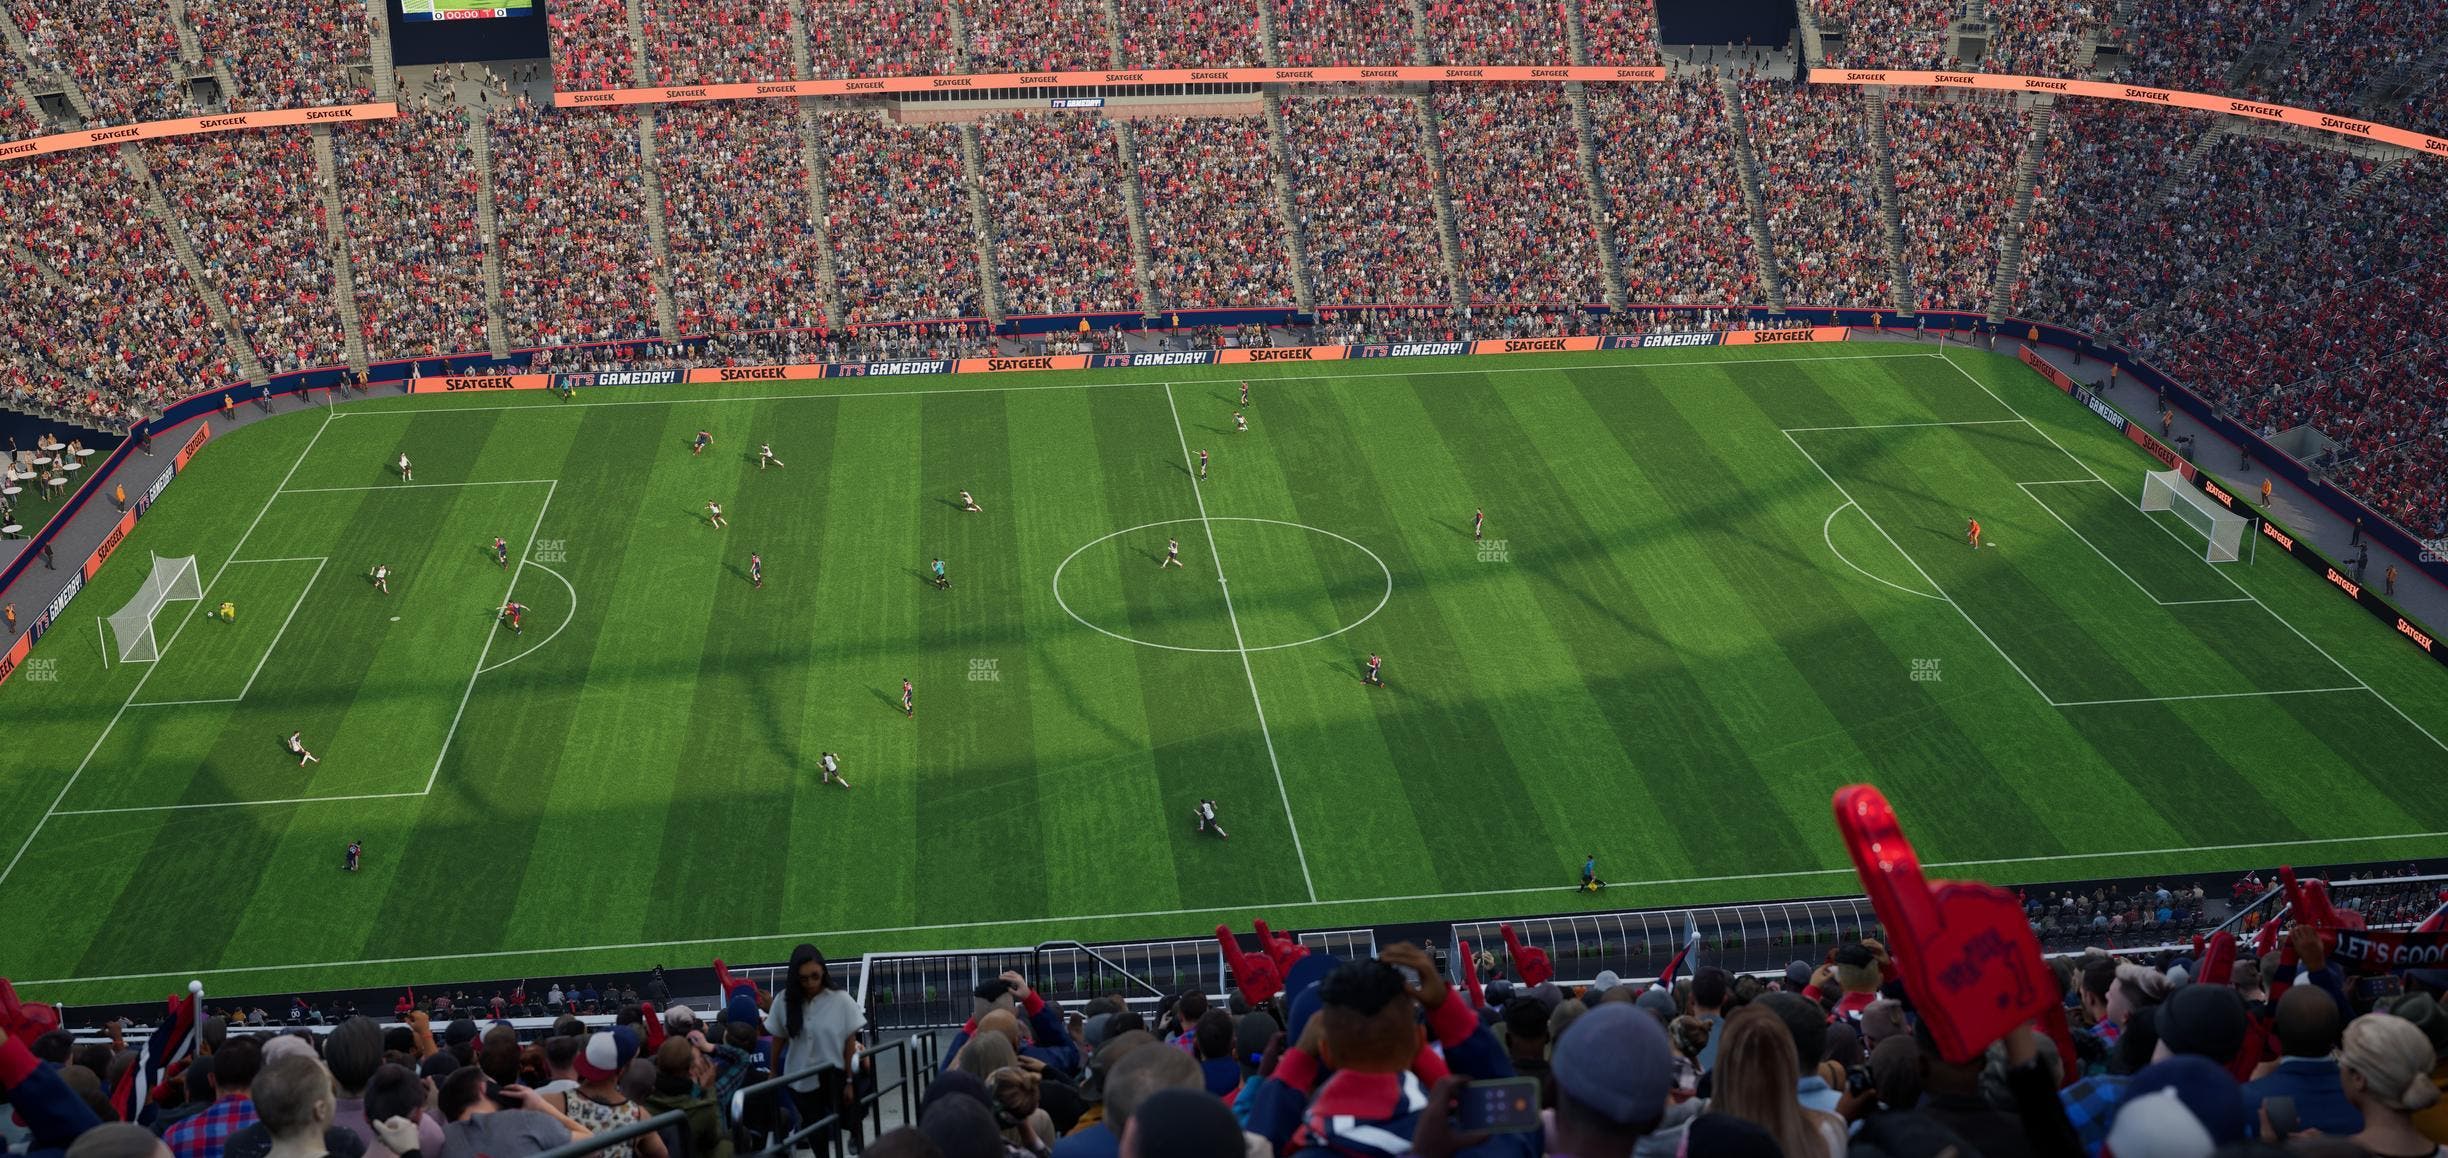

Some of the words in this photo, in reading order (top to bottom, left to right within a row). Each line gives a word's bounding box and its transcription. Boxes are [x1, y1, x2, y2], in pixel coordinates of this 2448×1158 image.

[446, 11, 479, 19] 00:00
[1020, 75, 1058, 85] SEATGEEK
[1105, 73, 1144, 82] SEATGEEK
[1191, 71, 1229, 81] SEATGEEK
[1276, 70, 1314, 80] SEATGEEK
[1360, 69, 1399, 78] SEATGEEK
[1445, 69, 1483, 78] SEATGEEK
[1531, 69, 1569, 78] SEATGEEK
[1617, 69, 1655, 78] SEATGEEK
[1847, 72, 1886, 82] SEATGEEK
[1935, 74, 1975, 85] SEATGEEK
[757, 85, 796, 95] SEATGEEK
[846, 81, 885, 91] SEATGEEK
[933, 78, 972, 88] SEATGEEK
[2025, 79, 2068, 91] SEATGEEK
[574, 93, 615, 103] SEATGEEK
[666, 89, 707, 99] SEATGEEK
[2125, 88, 2170, 102] SEATGEEK
[306, 108, 353, 120] SEATGEEK
[2230, 102, 2284, 118] SEATGEEK
[200, 115, 247, 129] SEATGEEK
[2320, 116, 2372, 135] SEATGEEK
[91, 127, 140, 142] SEATGEEK
[0, 142, 38, 155] EATGEEK
[2425, 137, 2448, 153] SEAT
[1615, 336, 1641, 348] IT'S
[1644, 334, 1712, 347] GAMEDAY!
[1754, 329, 1815, 343] SEATGEEK
[1362, 345, 1388, 358] IT'S
[1391, 343, 1463, 356] GAMEDAY!
[1505, 339, 1567, 352] SEATGEEK
[1103, 354, 1131, 368] IT'S
[1133, 352, 1207, 366] GAMEDAY!
[1250, 347, 1313, 362] SEATGEEK
[839, 364, 866, 377] IT'S
[869, 361, 944, 375] GAMEDAY!
[988, 357, 1053, 371] SEATGEEK
[2028, 354, 2056, 382] SEATGEEK
[569, 374, 595, 387] IT'S
[599, 371, 675, 385] GAMEDAY!
[720, 366, 787, 381] SEATGEEK
[446, 376, 515, 391] SEATGEEK
[185, 431, 207, 460] SEATGEEK
[2143, 434, 2176, 468] SEATGEEK
[2205, 481, 2233, 508] SEATGEEK
[98, 524, 124, 564] SEATGEEK
[2263, 522, 2293, 552] SEATGEEK
[2326, 568, 2359, 600] SEATGEEK
[50, 577, 82, 622] GAMEDAY!
[2396, 618, 2433, 652] SEATGEEK
[2335, 933, 2390, 964] LET'S
